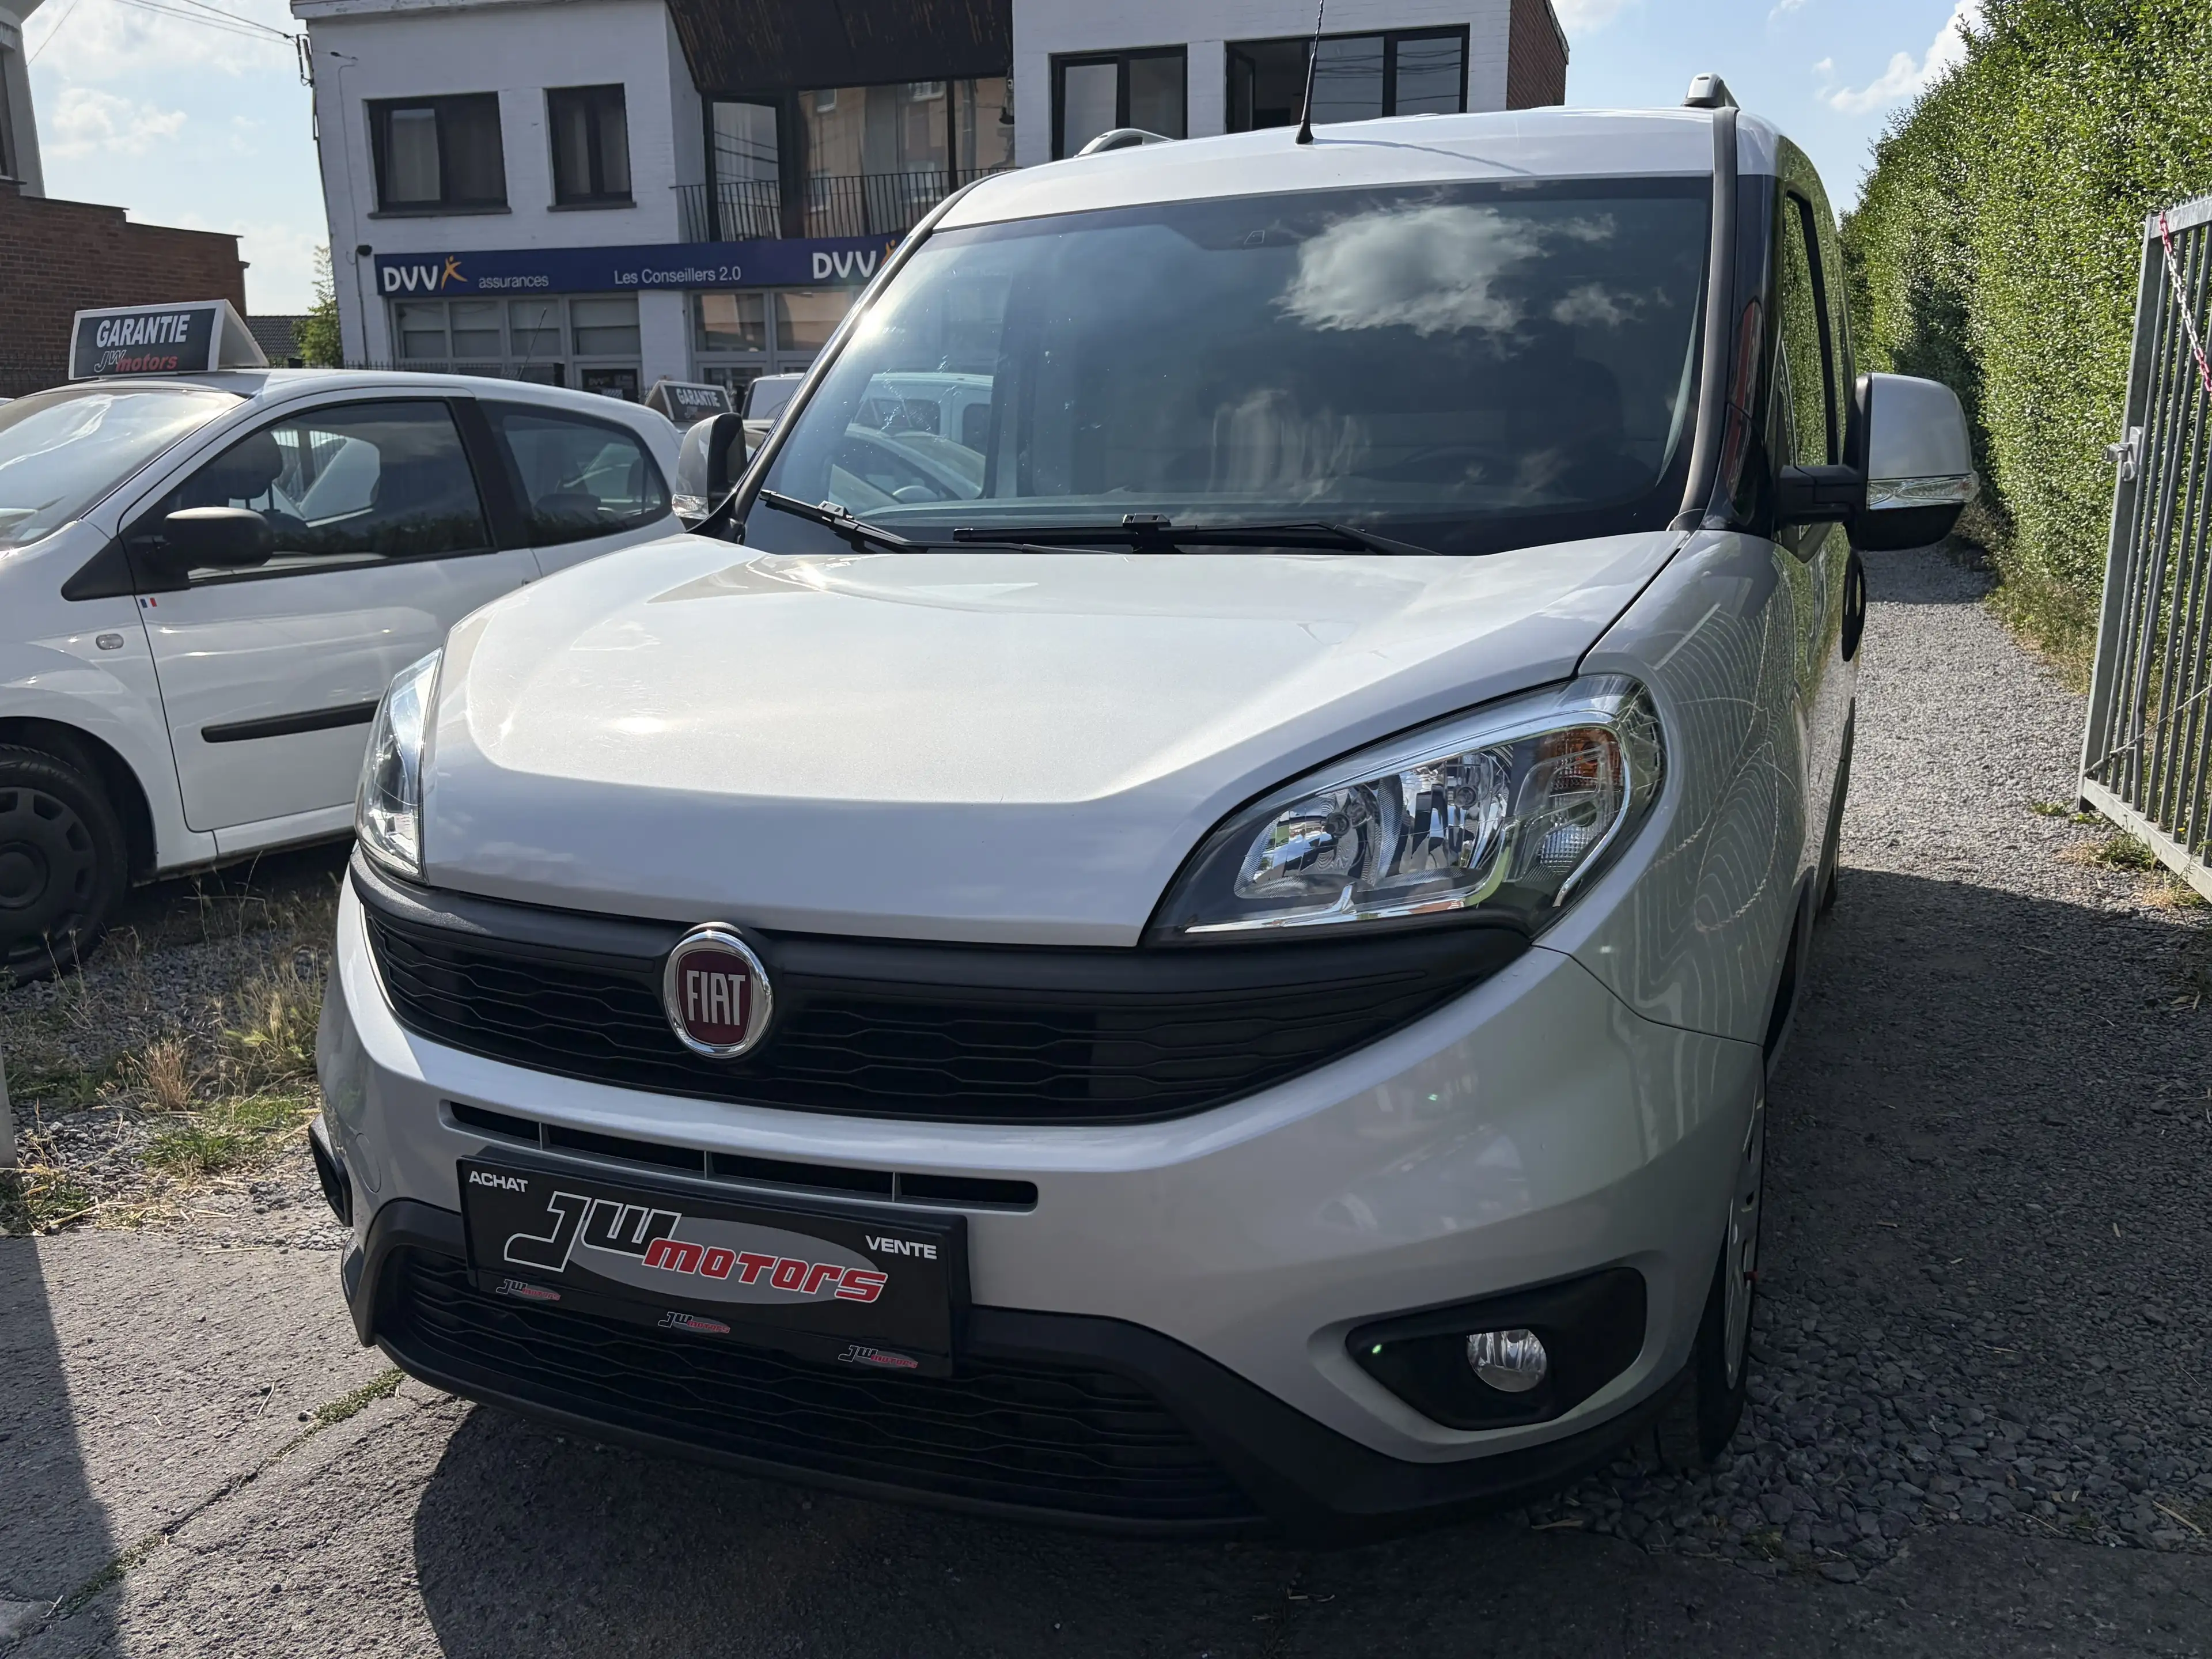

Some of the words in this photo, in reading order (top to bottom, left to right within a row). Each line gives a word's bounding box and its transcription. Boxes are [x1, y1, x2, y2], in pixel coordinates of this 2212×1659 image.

[614, 270, 638, 285] Les
[641, 267, 716, 283] Conseillers
[719, 266, 741, 281] 2.0
[812, 250, 877, 279] DVV
[382, 265, 439, 291] DVV
[478, 275, 549, 289] assurances
[96, 314, 191, 347] GARANTIE
[116, 353, 179, 372] motors
[676, 388, 721, 407] GARANTIE
[687, 969, 746, 1026] FIAT
[469, 1171, 528, 1192] ACHAT
[504, 1191, 683, 1272] JW
[865, 1234, 937, 1260] VENTE
